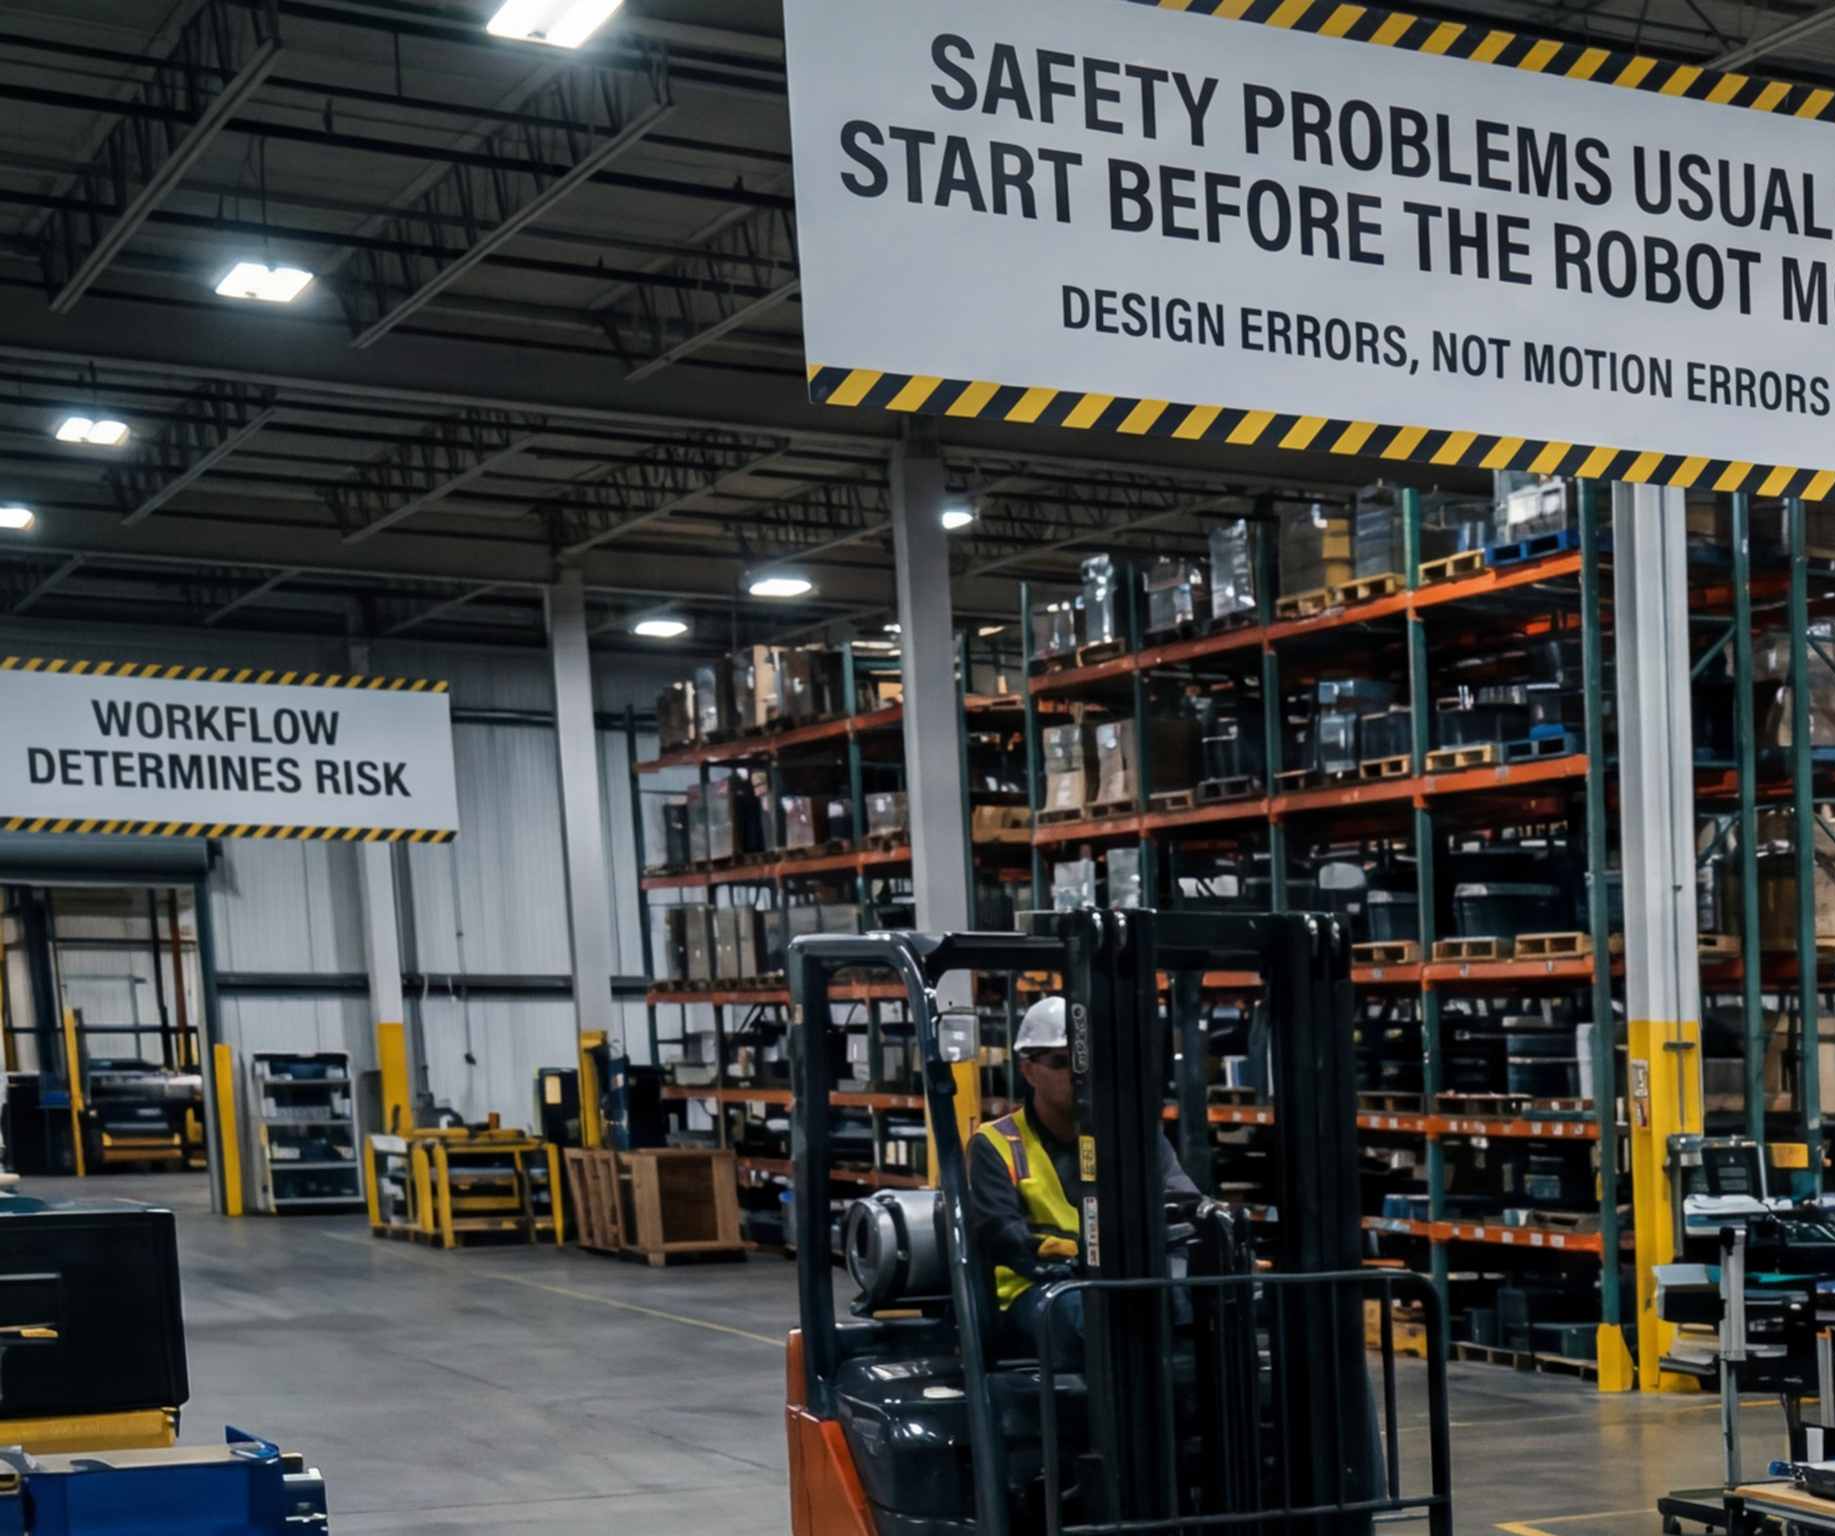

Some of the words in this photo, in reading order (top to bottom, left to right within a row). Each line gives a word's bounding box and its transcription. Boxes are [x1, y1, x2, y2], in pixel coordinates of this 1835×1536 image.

[932, 34, 1218, 146] SAFETY
[1244, 84, 1611, 205] PROBLEMS
[841, 120, 1082, 223] START
[1108, 159, 1384, 265] BEFORE
[1404, 202, 1531, 284] THE
[1555, 223, 1761, 314] ROBOT
[1063, 285, 1224, 346] DESIGN
[1241, 308, 1418, 374] ERRORS,
[1433, 331, 1510, 378] NOT
[1525, 342, 1672, 397] MOTION
[1688, 362, 1829, 415] ERRORS
[28, 748, 301, 792] DETERMINES
[315, 758, 412, 797] RISK
[92, 700, 338, 745] WORKFLOW
